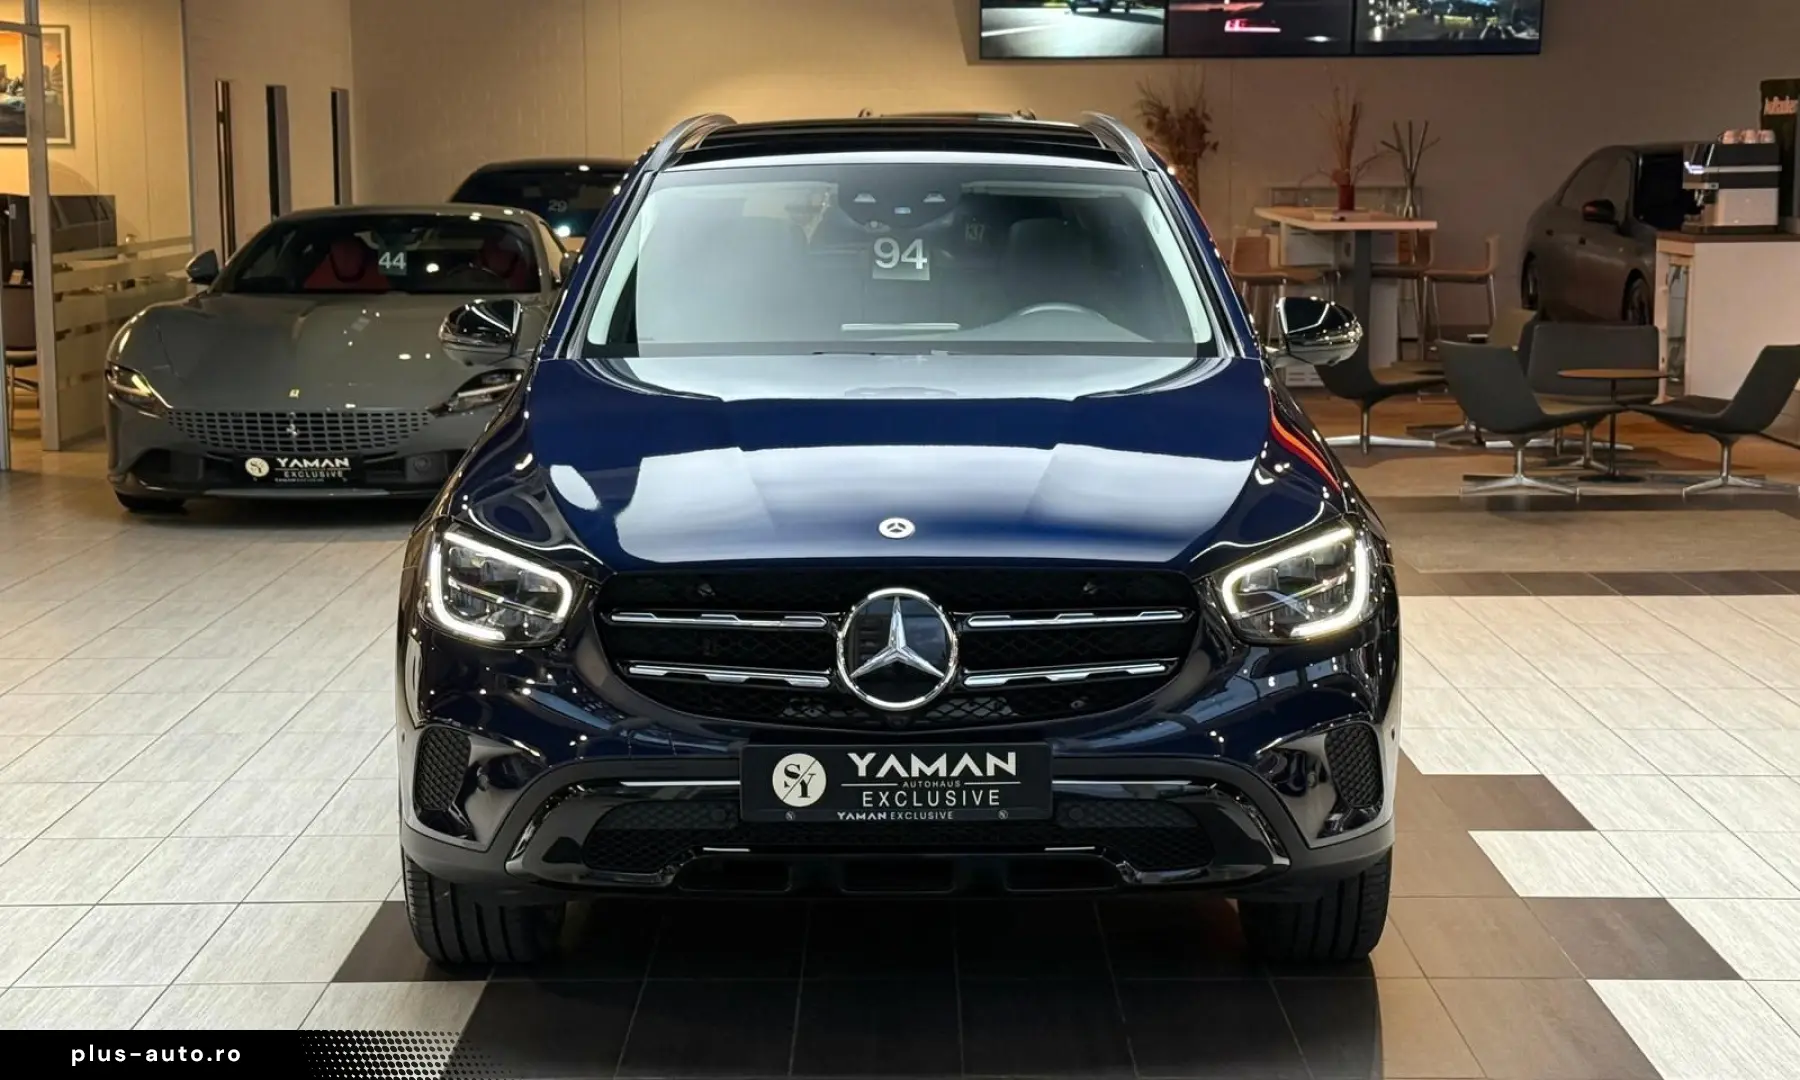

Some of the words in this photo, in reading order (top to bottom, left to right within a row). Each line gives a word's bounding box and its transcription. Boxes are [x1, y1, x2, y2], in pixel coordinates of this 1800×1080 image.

[548, 200, 568, 213] 29
[873, 237, 928, 270] 94
[378, 251, 407, 270] 44
[276, 457, 350, 468] YAMAN
[283, 470, 343, 478] EXCLUSIVE
[847, 751, 1016, 778] YAMAN
[902, 779, 961, 789] AUTOHAUS
[862, 789, 1000, 808] EXCLUSIVE
[837, 811, 887, 820] YAMAN
[890, 810, 953, 820] EXCLUSIVE
